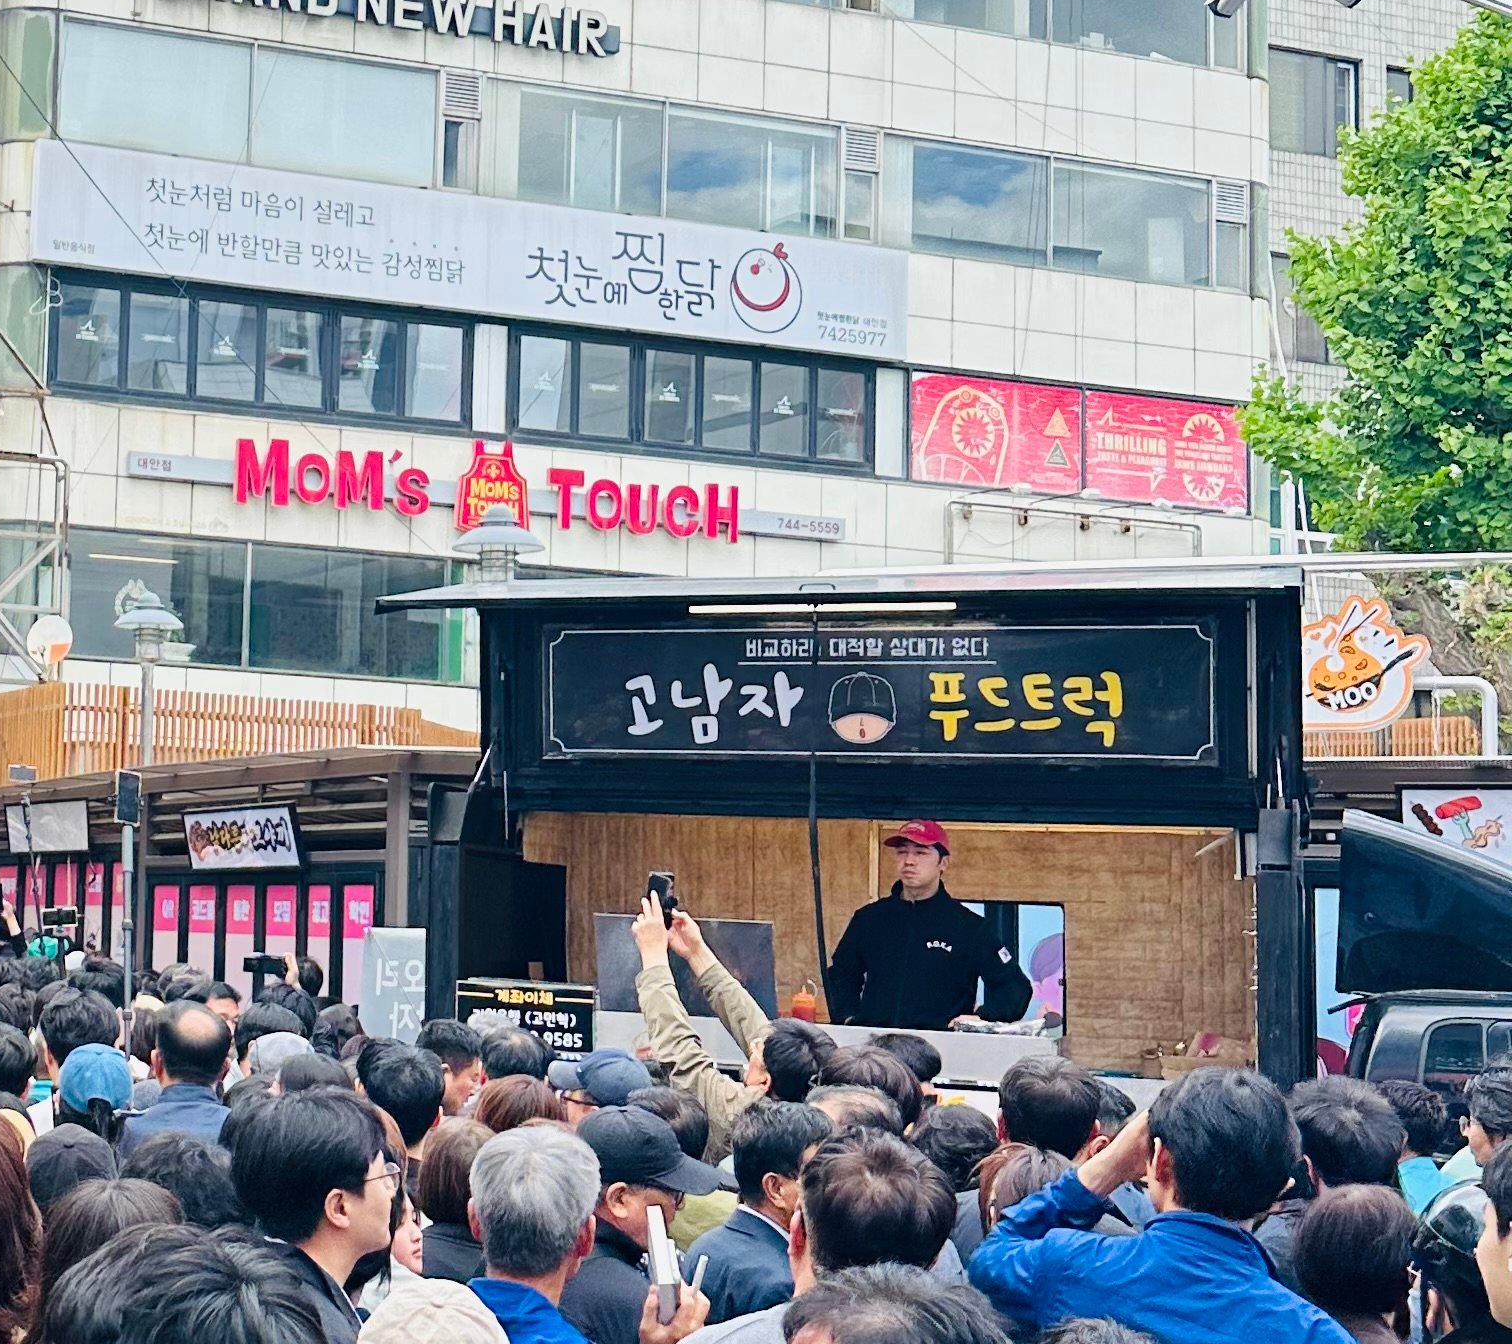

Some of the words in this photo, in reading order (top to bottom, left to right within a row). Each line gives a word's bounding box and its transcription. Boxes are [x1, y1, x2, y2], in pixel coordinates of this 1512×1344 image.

[145, 177, 233, 213] 첫눈처럼
[242, 190, 304, 221] 마음이
[313, 199, 376, 227] 설레고
[143, 223, 208, 254] 첫눈에
[217, 233, 304, 265] 반할만큼
[312, 244, 374, 274] 맛있는
[382, 252, 466, 285] 감성찜닭
[818, 325, 887, 348] 7425977
[1096, 432, 1167, 456] THRILLING
[137, 458, 172, 473] 대안점
[546, 467, 739, 544] TOUCH
[777, 518, 840, 534] 744-5559
[829, 637, 883, 657] 대적할
[890, 637, 945, 657] 상대가
[952, 636, 989, 657] 없다
[624, 662, 804, 744] 고남자
[928, 670, 1123, 748] 푸드트럭
[494, 989, 553, 1006] 계좌이체
